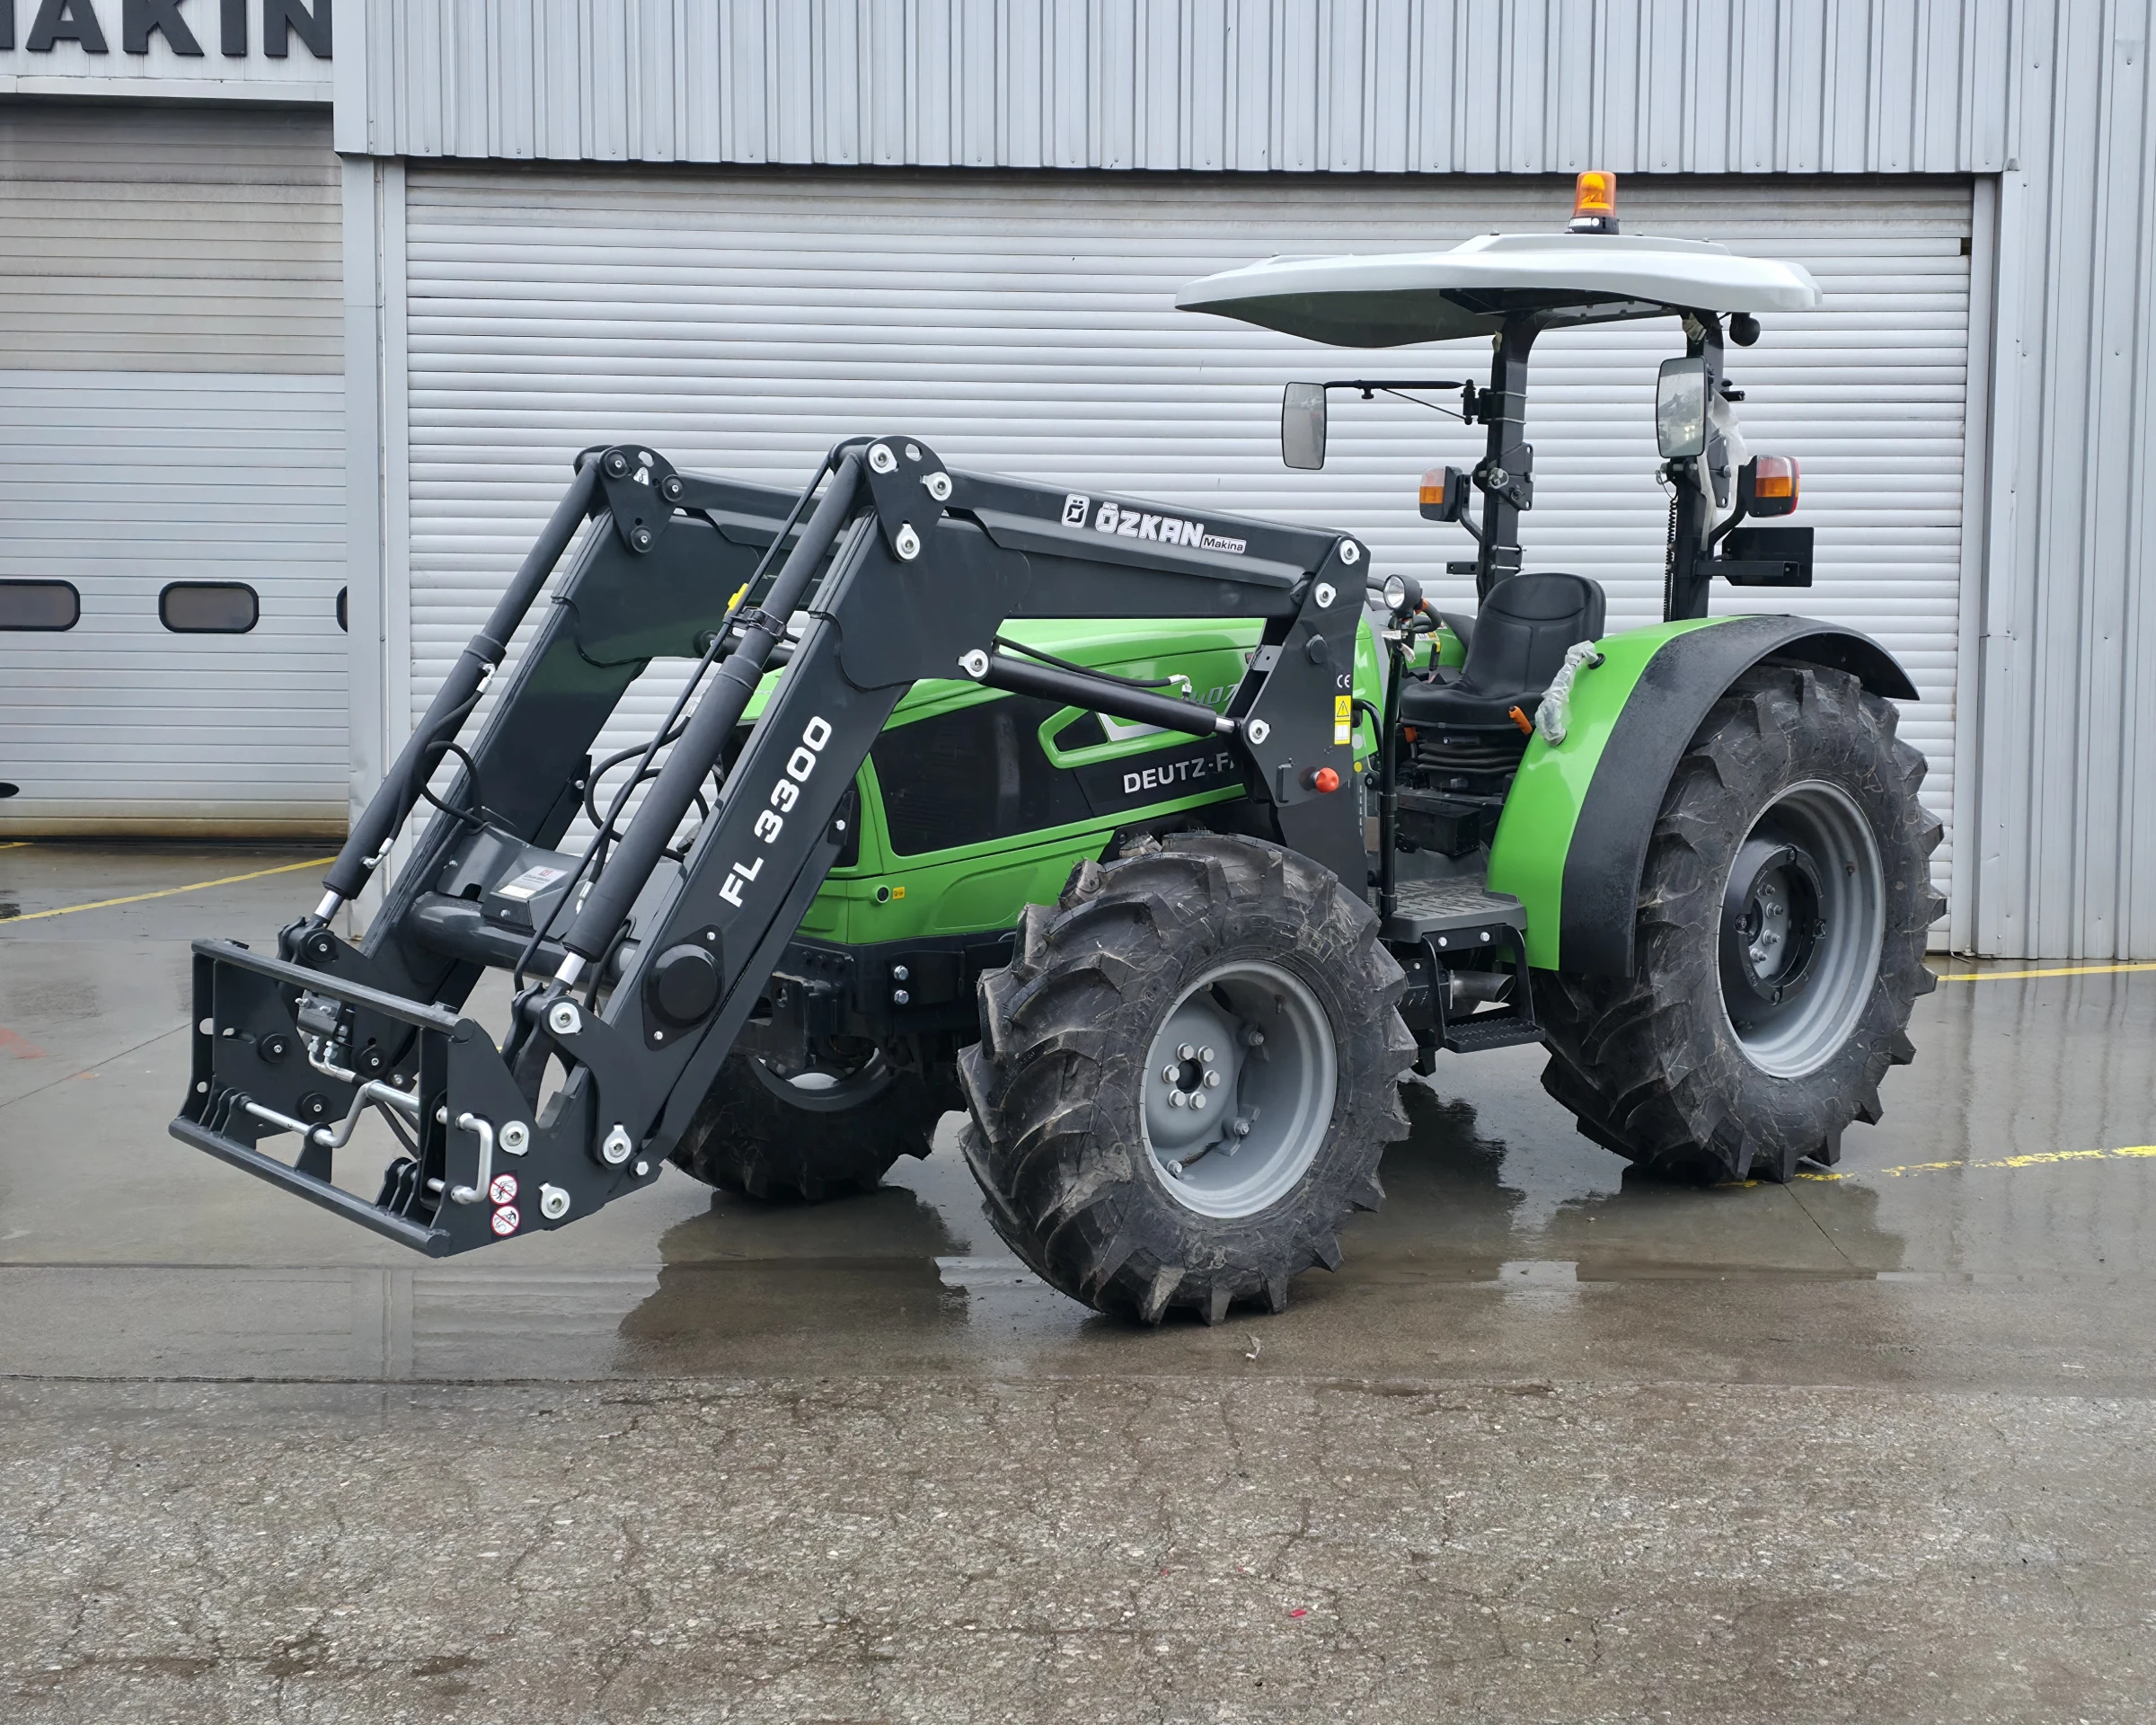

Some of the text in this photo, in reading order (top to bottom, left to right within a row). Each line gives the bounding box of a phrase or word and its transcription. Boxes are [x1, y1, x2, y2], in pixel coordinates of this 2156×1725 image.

[0, 0, 332, 58] AKIN
[1095, 502, 1204, 547] ÖZKAN
[1204, 536, 1243, 552] Makina
[719, 716, 832, 907] FL 3300
